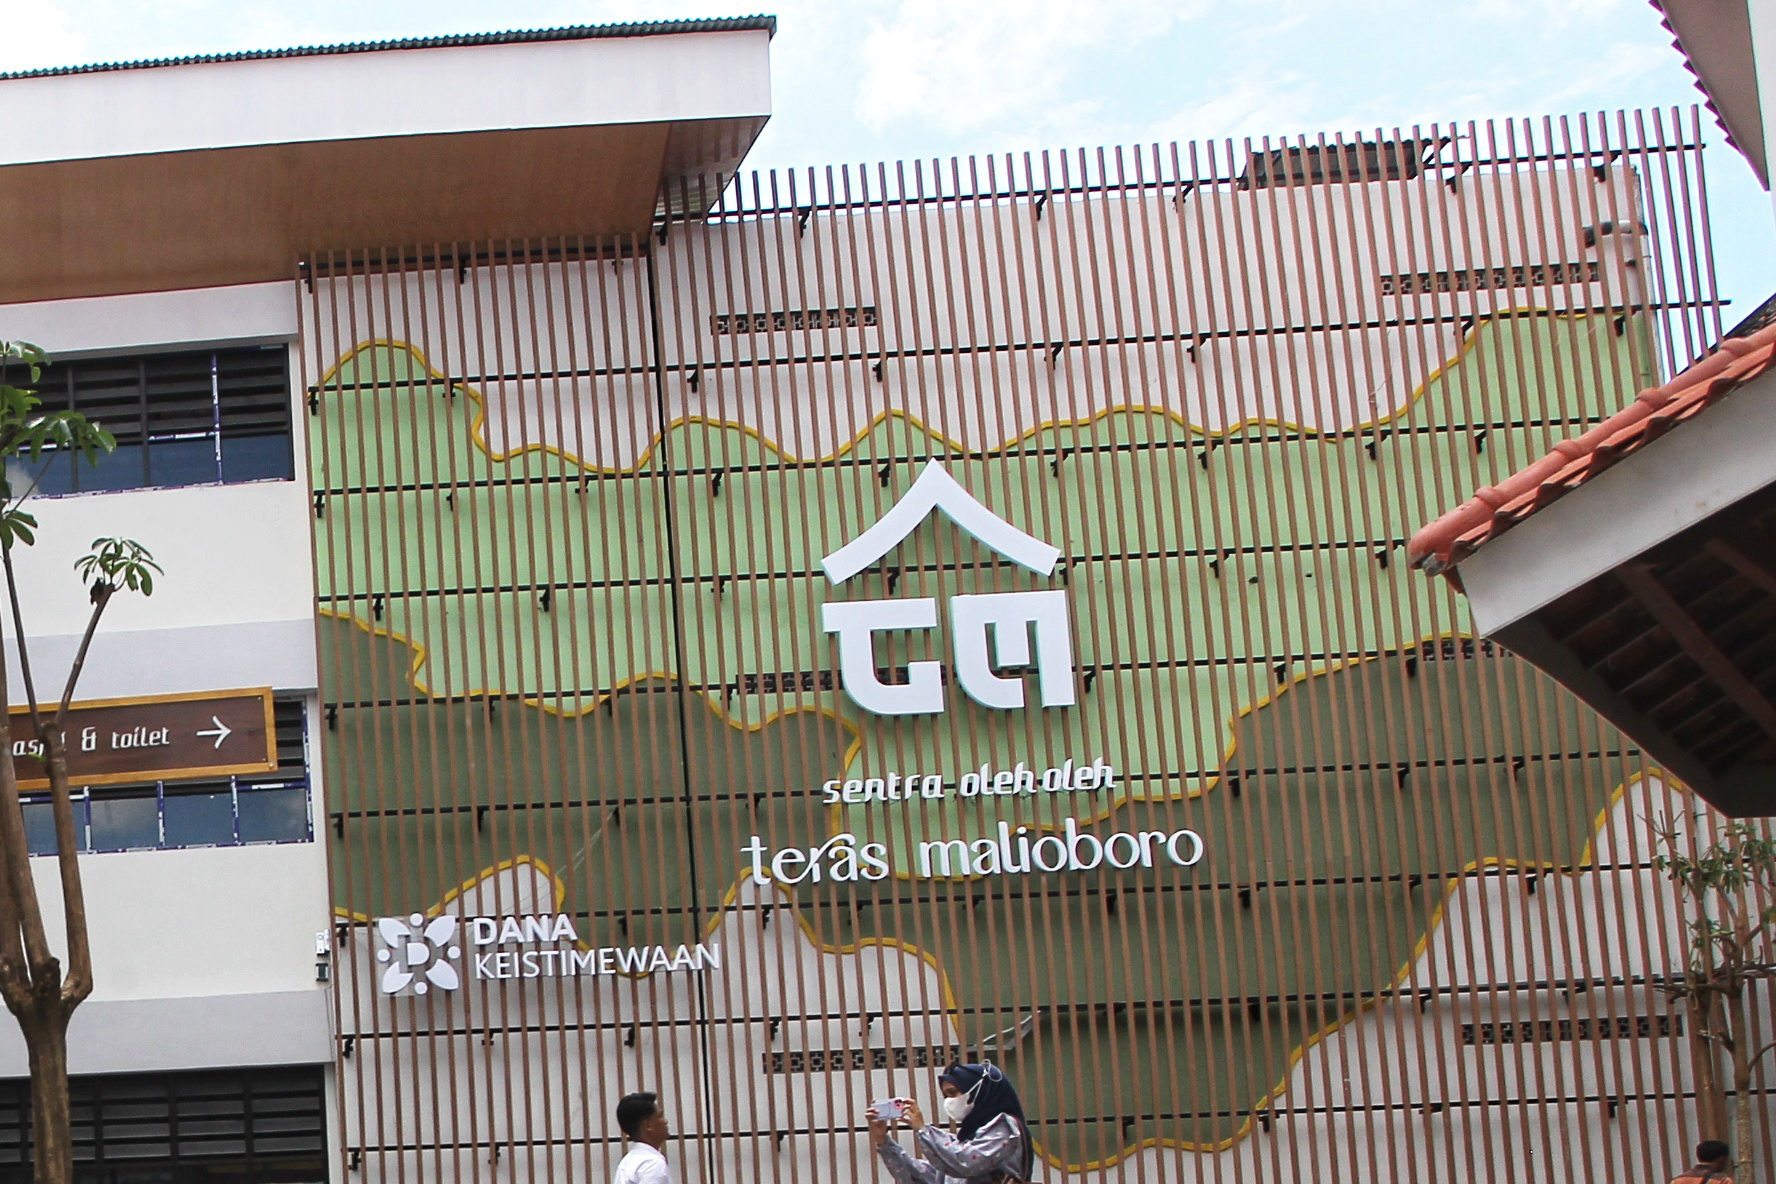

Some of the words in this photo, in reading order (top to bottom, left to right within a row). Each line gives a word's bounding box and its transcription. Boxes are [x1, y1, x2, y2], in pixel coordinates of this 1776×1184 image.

[81, 726, 97, 751] &
[112, 726, 170, 749] toilet
[822, 771, 945, 804] sentra
[960, 761, 1037, 797] oleh
[1042, 756, 1117, 792] oleh
[919, 817, 1204, 878] malioboro
[474, 914, 578, 944] DANA
[475, 943, 721, 979] KEISTIMEWAAN
